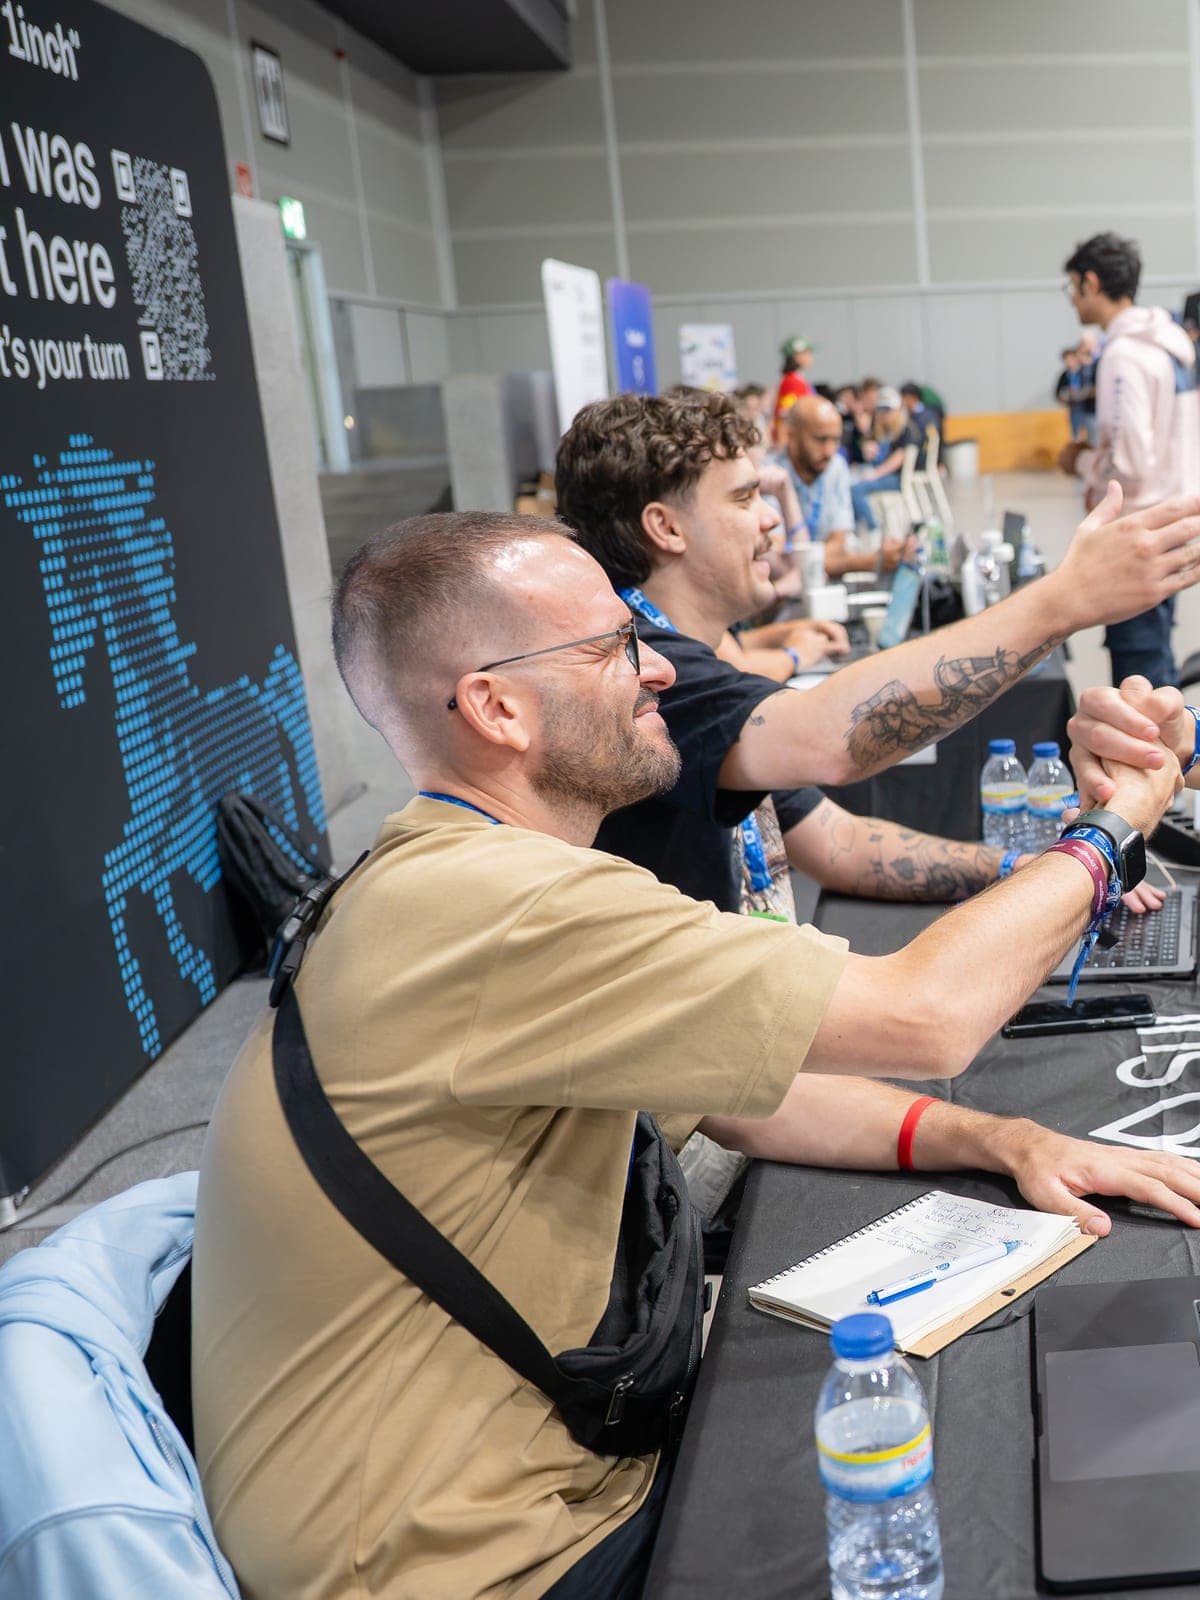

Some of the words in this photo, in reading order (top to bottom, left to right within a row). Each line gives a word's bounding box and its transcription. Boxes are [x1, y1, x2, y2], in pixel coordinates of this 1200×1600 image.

[11, 121, 101, 210] was
[15, 206, 117, 309] here
[29, 337, 83, 390] your
[84, 333, 131, 380] turn
